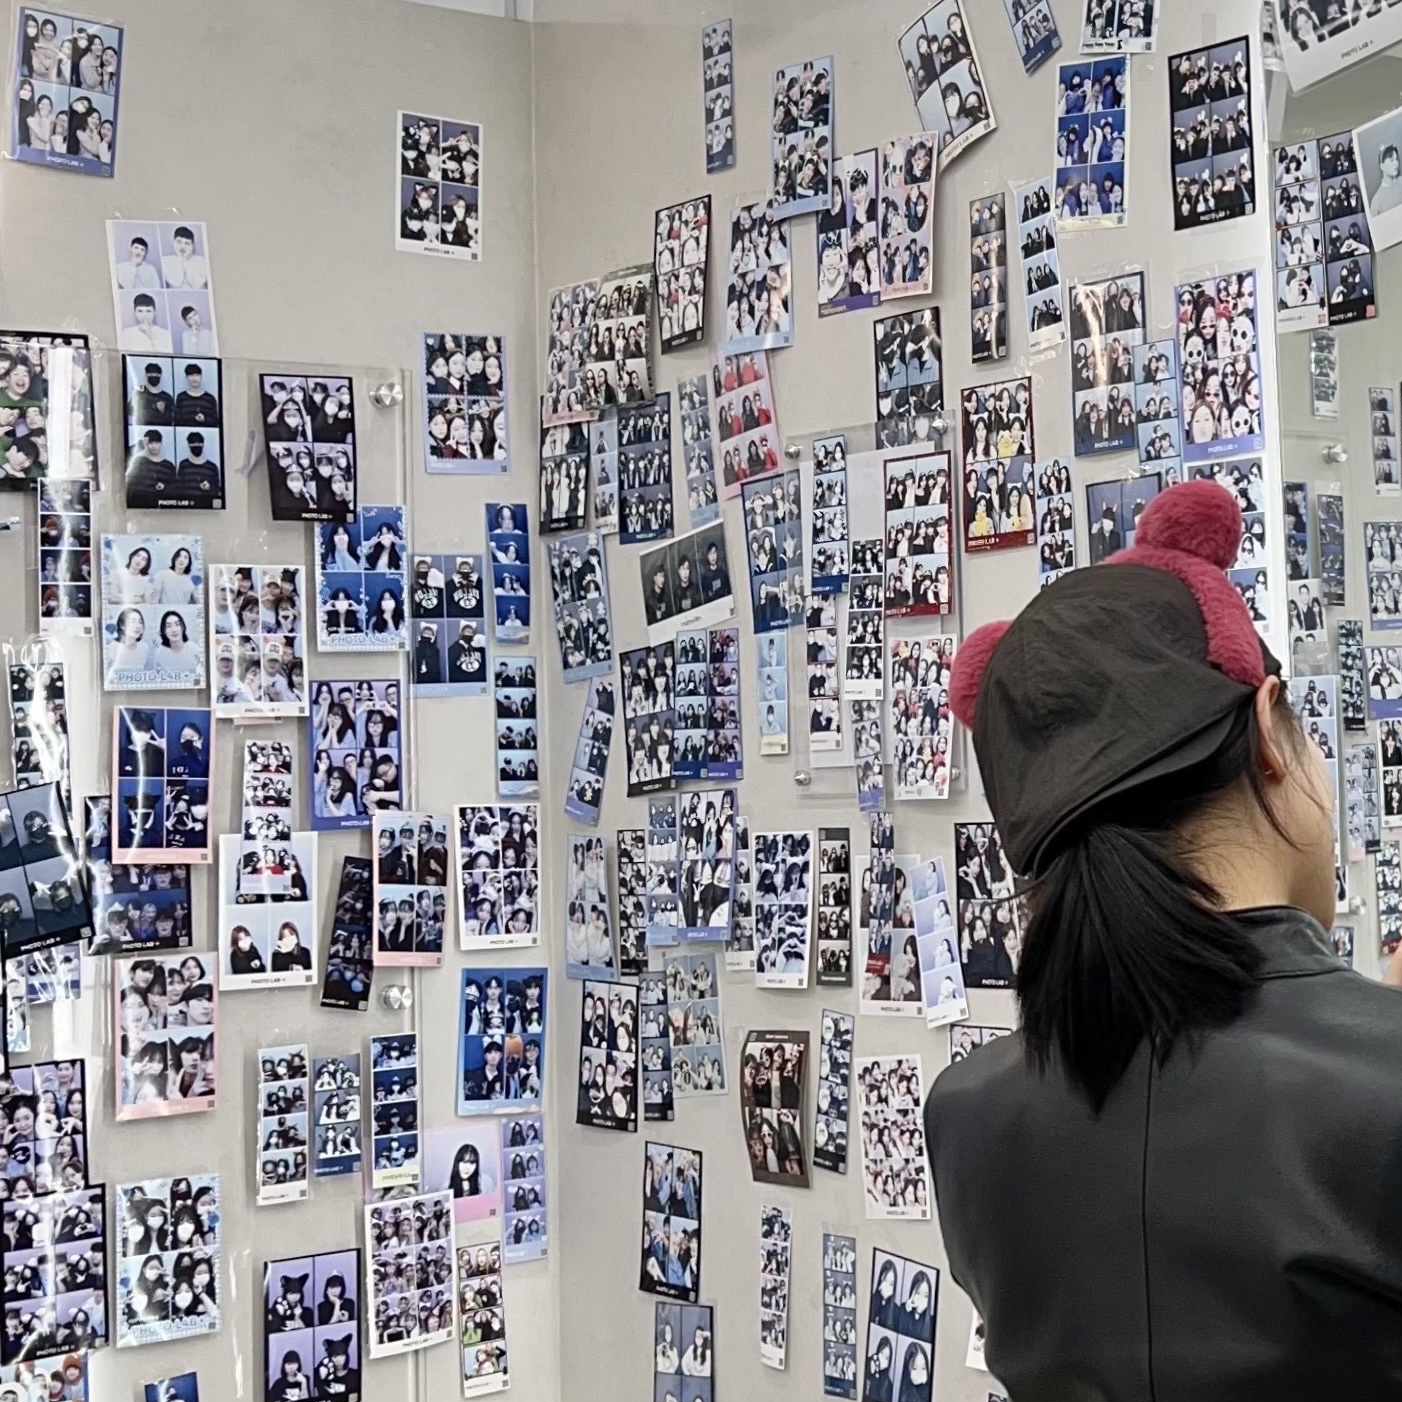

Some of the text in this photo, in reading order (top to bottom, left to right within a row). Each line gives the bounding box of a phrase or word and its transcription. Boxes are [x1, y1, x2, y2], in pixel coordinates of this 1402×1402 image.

[1340, 46, 1357, 59] PHOTO
[1358, 41, 1369, 52] LAB
[331, 634, 366, 645] PHOTO
[368, 633, 388, 644] LAB
[119, 672, 157, 683] PHOTO
[160, 671, 181, 682] LAB
[21, 942, 40, 951] PHOTO
[41, 939, 55, 947] LAB
[982, 978, 994, 986] PHOTO
[36, 1347, 56, 1357] PHOTO
[57, 1345, 69, 1353] LAB
